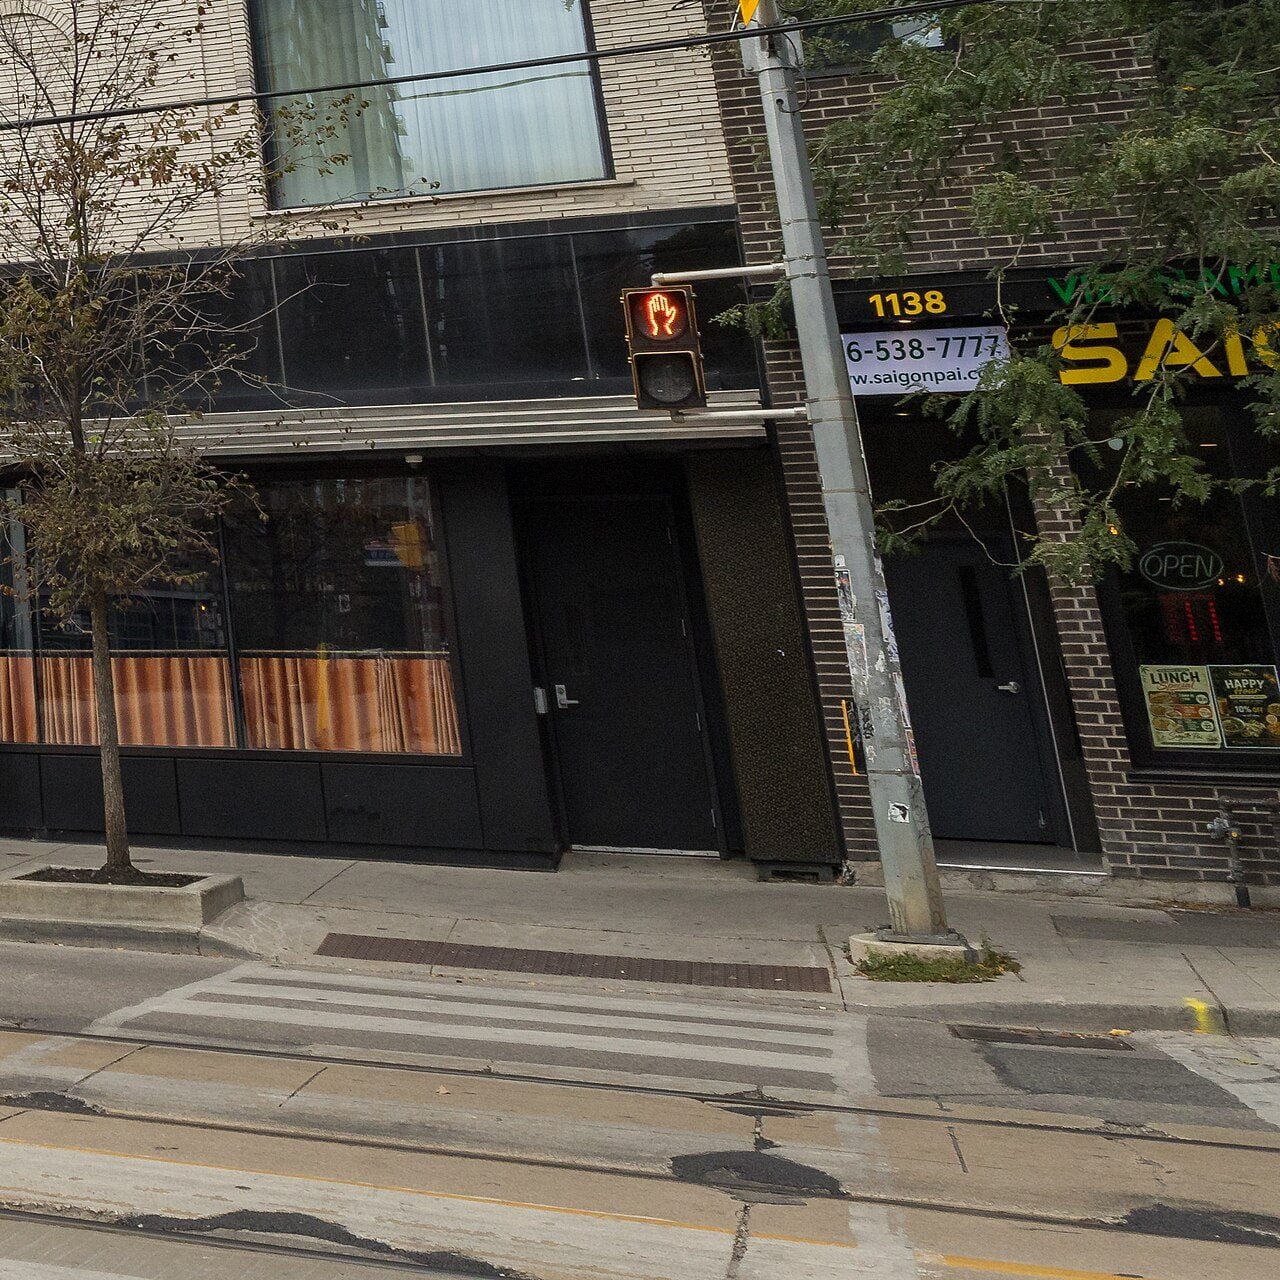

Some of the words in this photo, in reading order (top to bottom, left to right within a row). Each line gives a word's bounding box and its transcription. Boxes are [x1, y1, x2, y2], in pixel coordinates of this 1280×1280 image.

[868, 290, 947, 317] 1138
[846, 335, 1000, 363] 6-538-7777
[1145, 555, 1214, 577] OPEN
[1149, 671, 1200, 685] LUNCH
[1224, 679, 1264, 689] HAPPY
